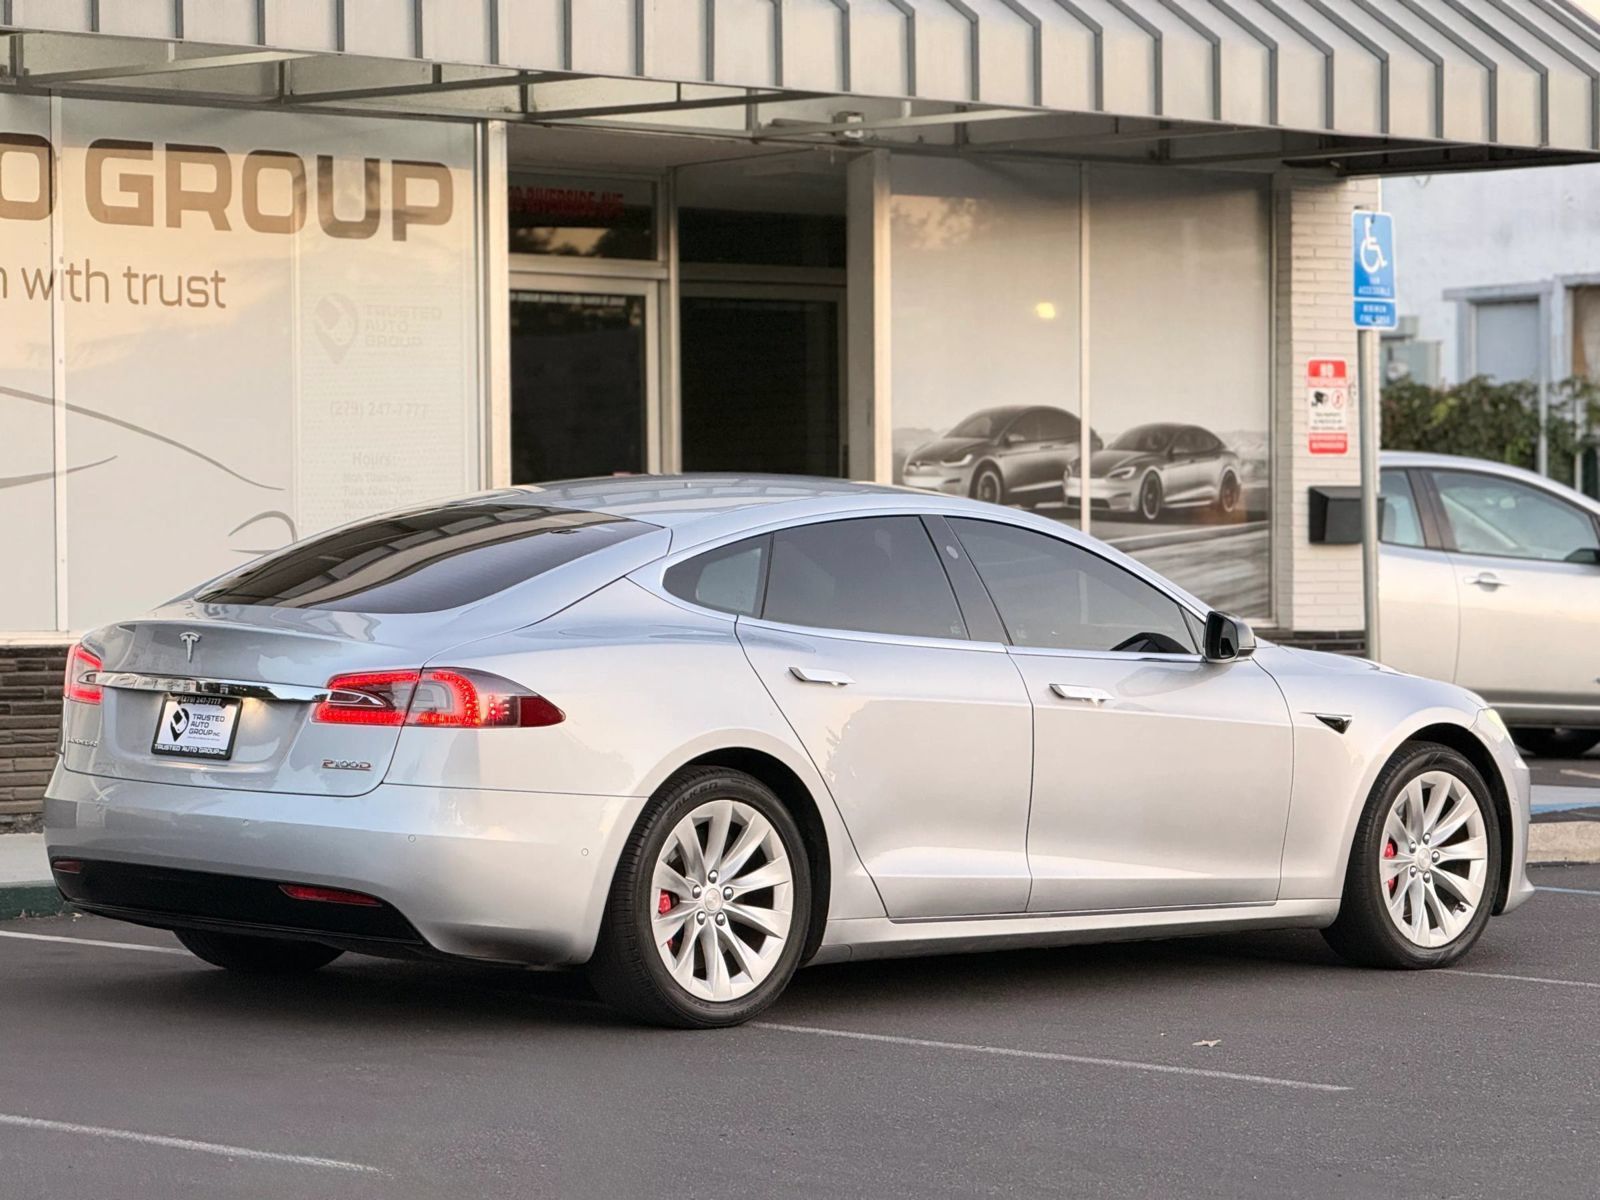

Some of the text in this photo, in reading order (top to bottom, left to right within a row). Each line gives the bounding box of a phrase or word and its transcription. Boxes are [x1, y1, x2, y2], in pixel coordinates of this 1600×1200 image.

[85, 138, 454, 242] GROUP
[21, 257, 110, 304] with
[123, 264, 227, 309] trust
[366, 304, 443, 321] TRUSTED
[365, 319, 409, 333] AUTO
[365, 335, 424, 348] GROUP
[192, 713, 225, 722] TRUSTED
[188, 728, 213, 736] GROUP
[154, 743, 181, 752] TRUSTED
[181, 745, 198, 753] AUTO
